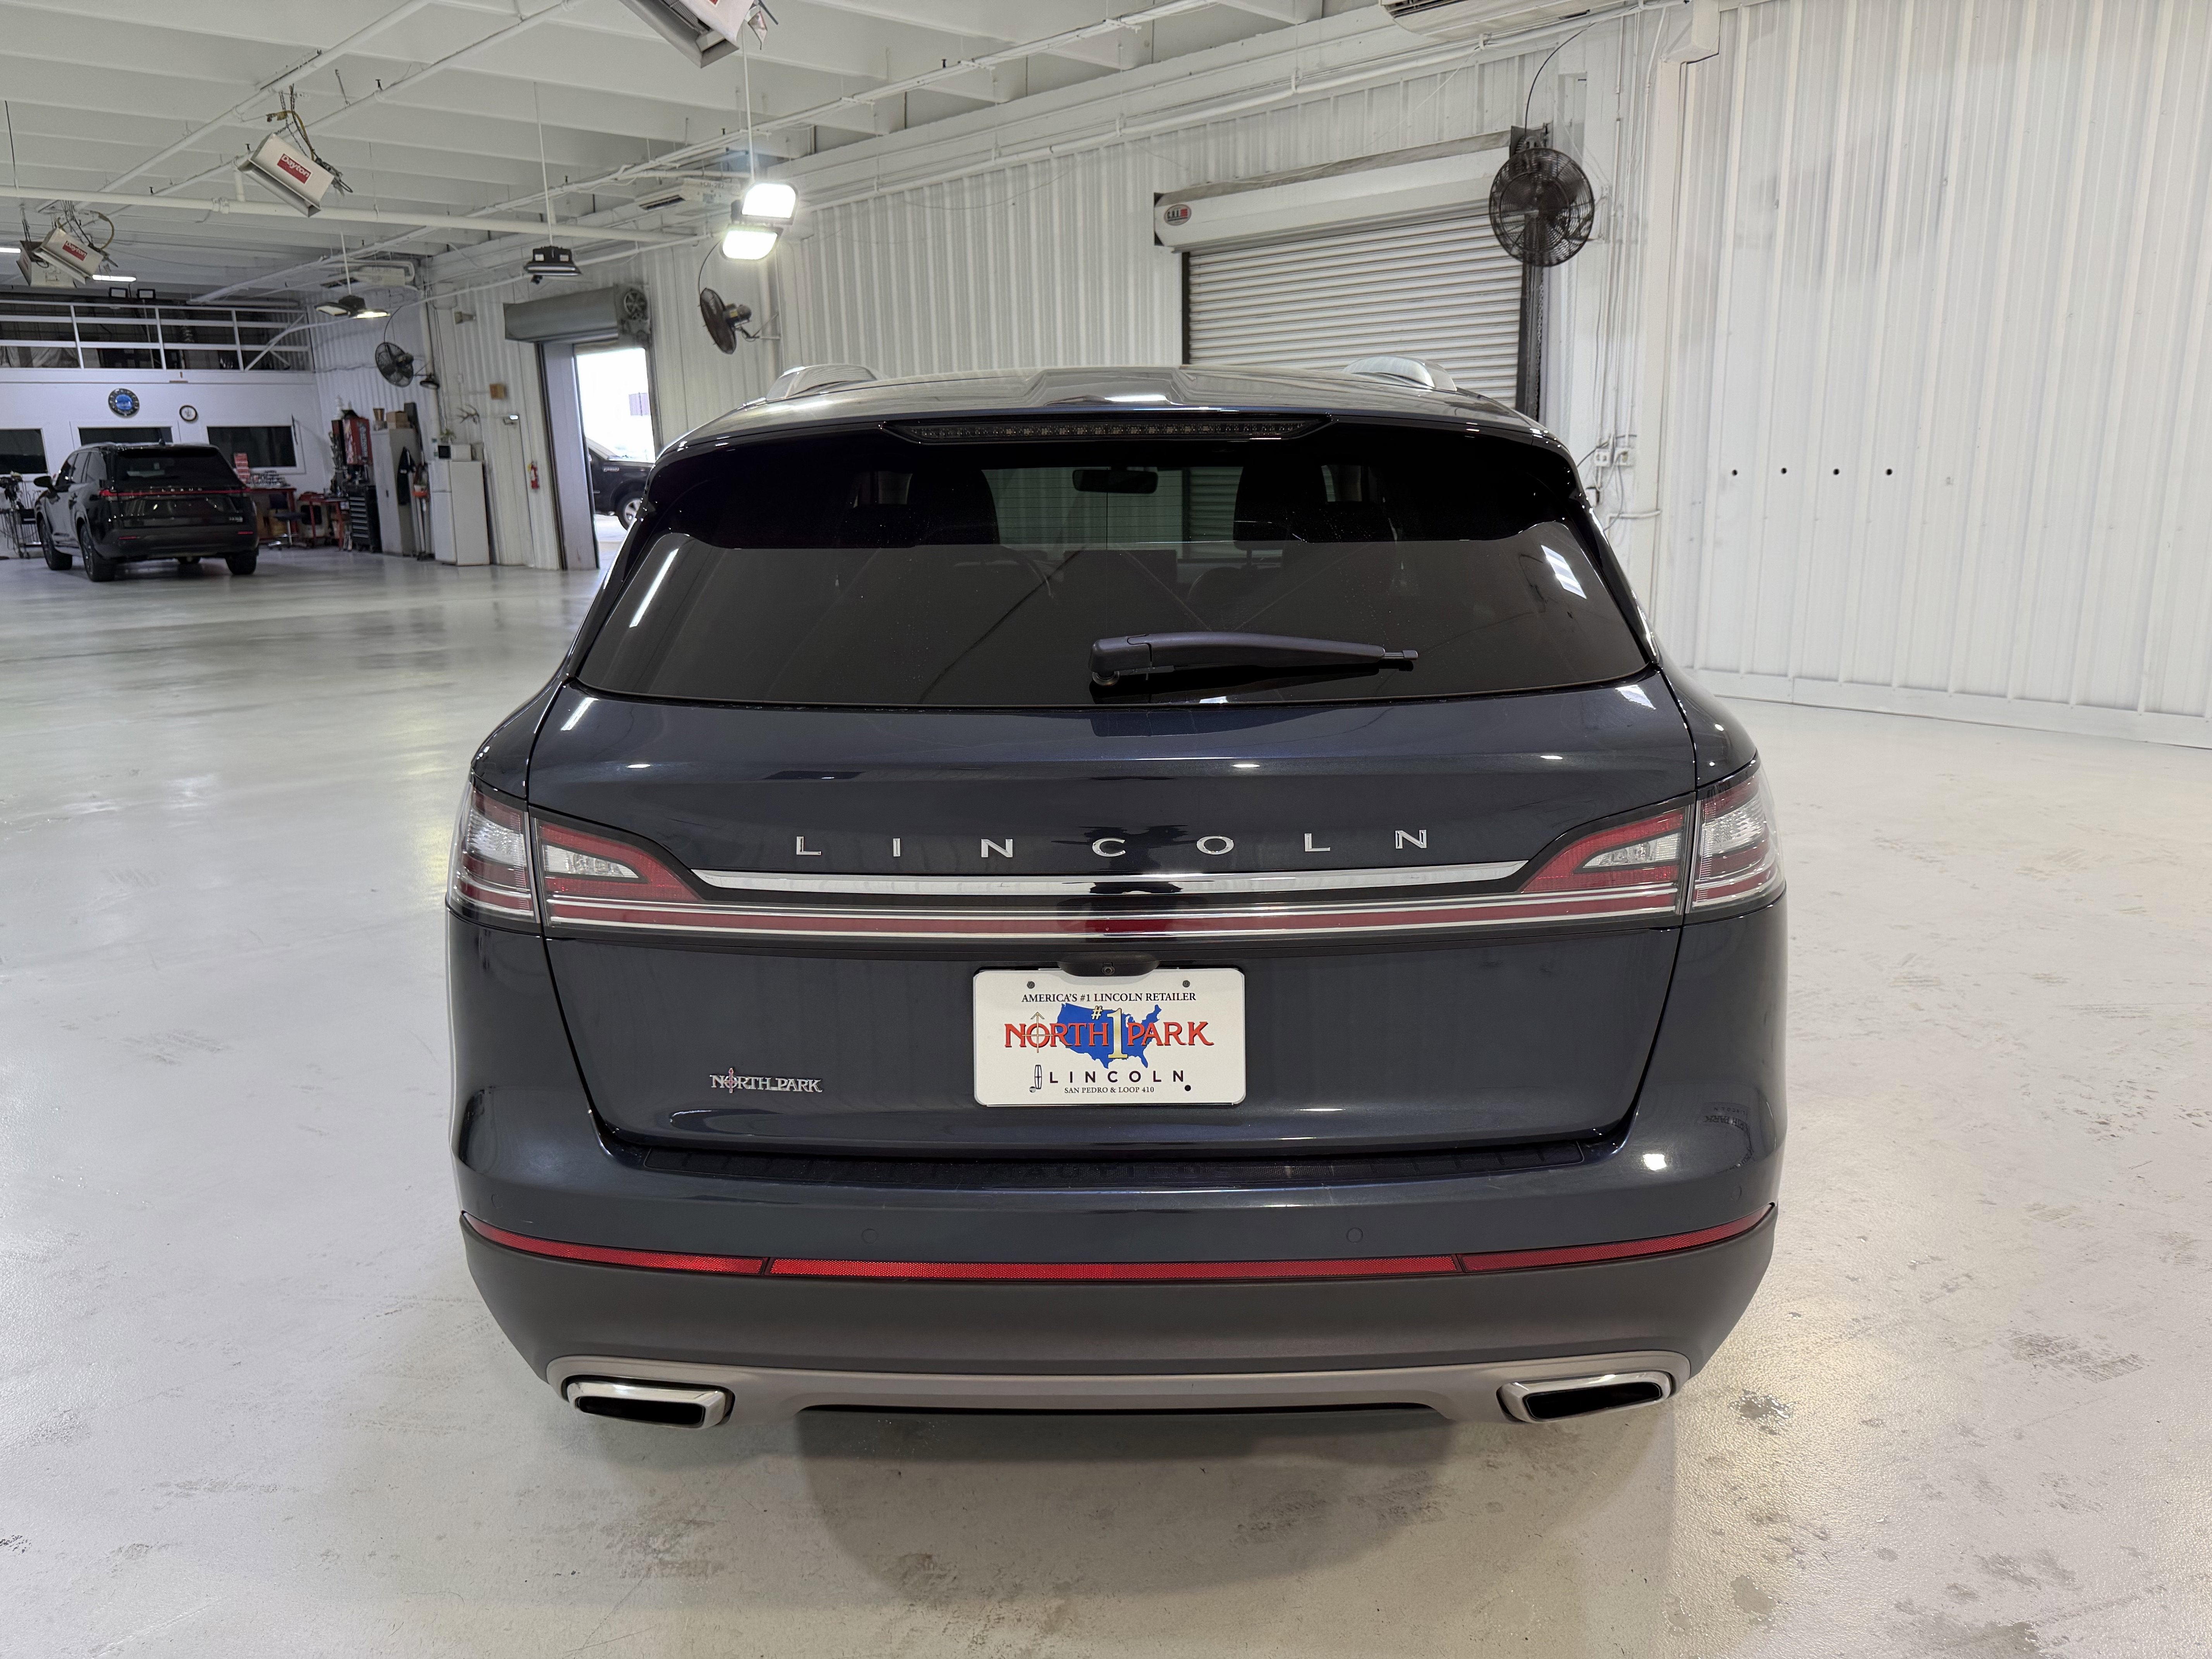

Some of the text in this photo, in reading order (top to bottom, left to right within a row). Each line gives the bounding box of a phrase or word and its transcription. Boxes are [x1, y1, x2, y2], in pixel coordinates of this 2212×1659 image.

[281, 155, 310, 178] Dayton
[65, 241, 87, 257] Dayton
[796, 829, 1427, 858] LINCOLN
[1021, 993, 1196, 1003] AMERICA'S #1 LINCOLN RETAILER
[1004, 1021, 1215, 1048] NORTH PARK
[709, 1074, 823, 1092] NORTH PARK
[1049, 1070, 1183, 1084] LINCOLN
